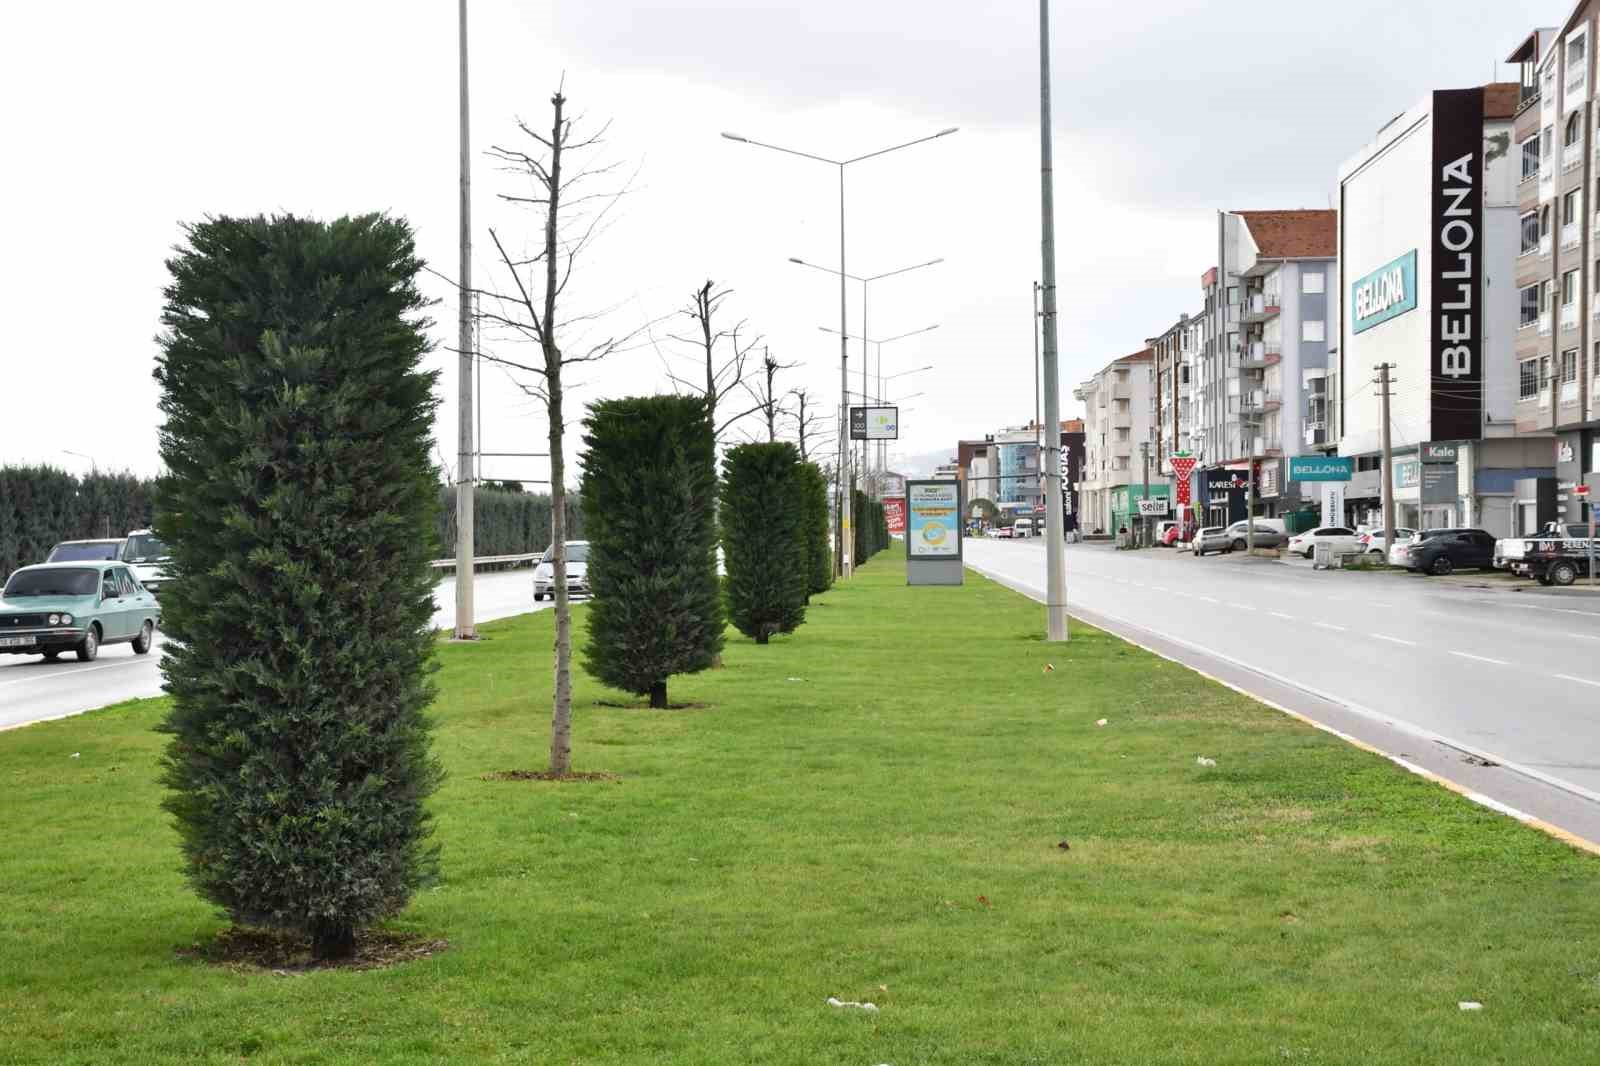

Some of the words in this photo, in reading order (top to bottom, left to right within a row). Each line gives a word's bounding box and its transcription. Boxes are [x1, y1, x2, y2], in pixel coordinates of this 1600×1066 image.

[1441, 152, 1474, 378] BELLONA
[1356, 266, 1404, 320] BELLONA
[1429, 446, 1455, 457] Kale
[1294, 465, 1348, 474] BELLONA
